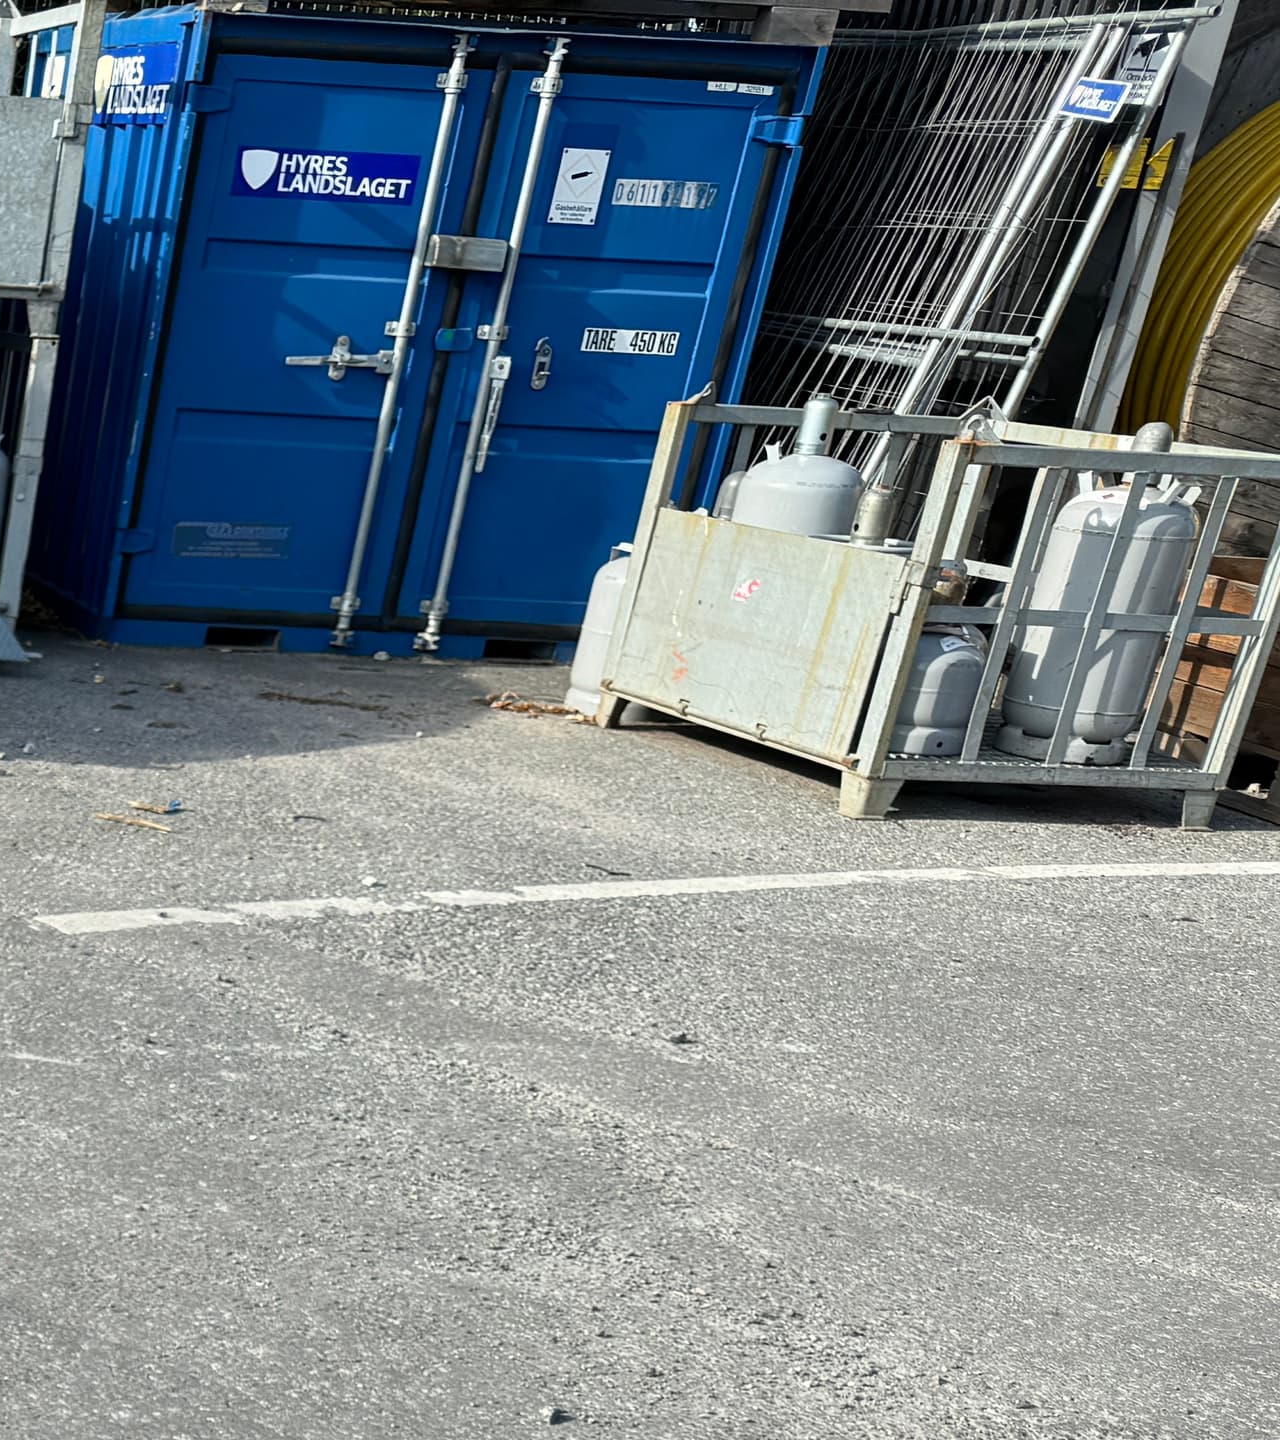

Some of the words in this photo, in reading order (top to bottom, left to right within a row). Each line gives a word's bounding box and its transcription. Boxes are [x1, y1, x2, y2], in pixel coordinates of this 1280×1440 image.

[111, 56, 146, 86] HYRES
[106, 85, 170, 114] LANDSLAGET
[281, 153, 348, 176] HYRES
[277, 173, 412, 199] LANDSLAGET
[584, 329, 618, 351] TARE
[629, 331, 657, 353] 450
[657, 333, 677, 354] KG
